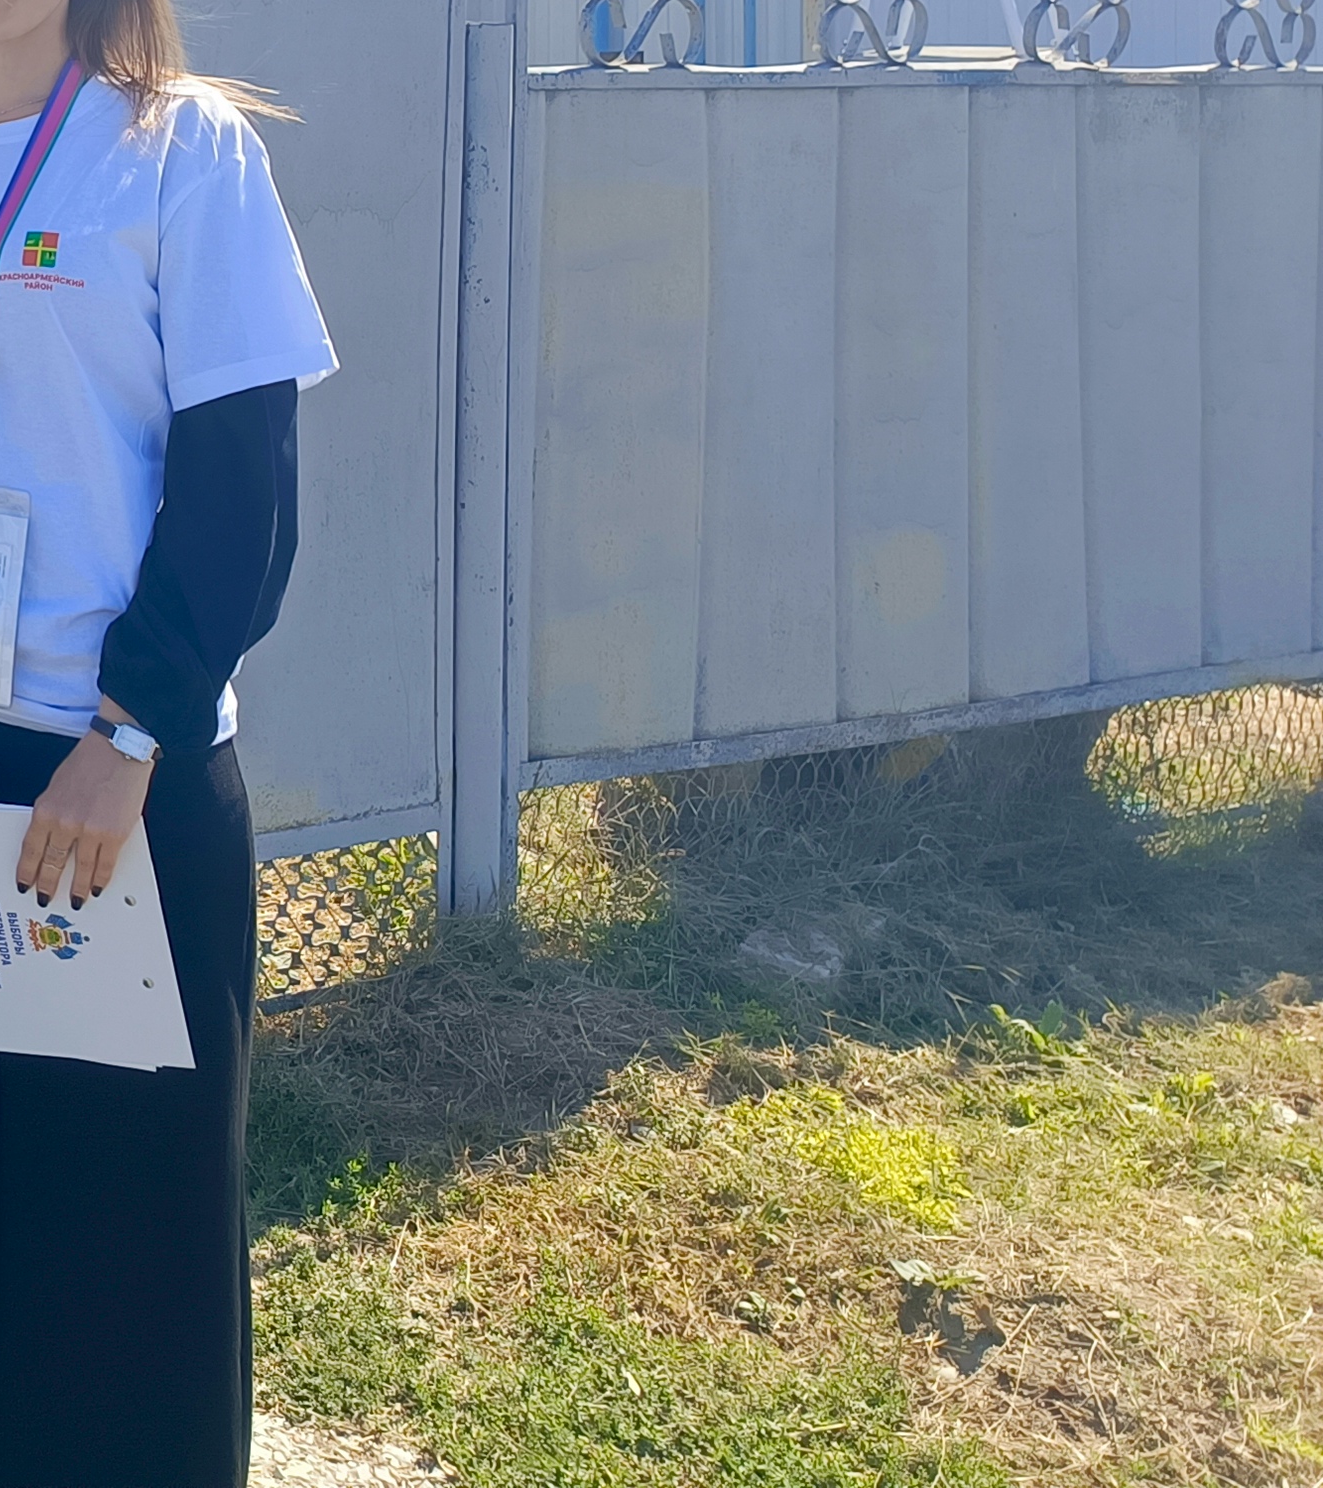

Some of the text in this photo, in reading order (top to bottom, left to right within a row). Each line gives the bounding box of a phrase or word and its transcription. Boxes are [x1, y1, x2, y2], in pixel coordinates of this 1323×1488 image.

[0, 273, 84, 288] КРАСНОАРМЕЙСКИЙ
[24, 282, 53, 291] РАЙОН
[7, 912, 26, 955] ВЫБОРЫ
